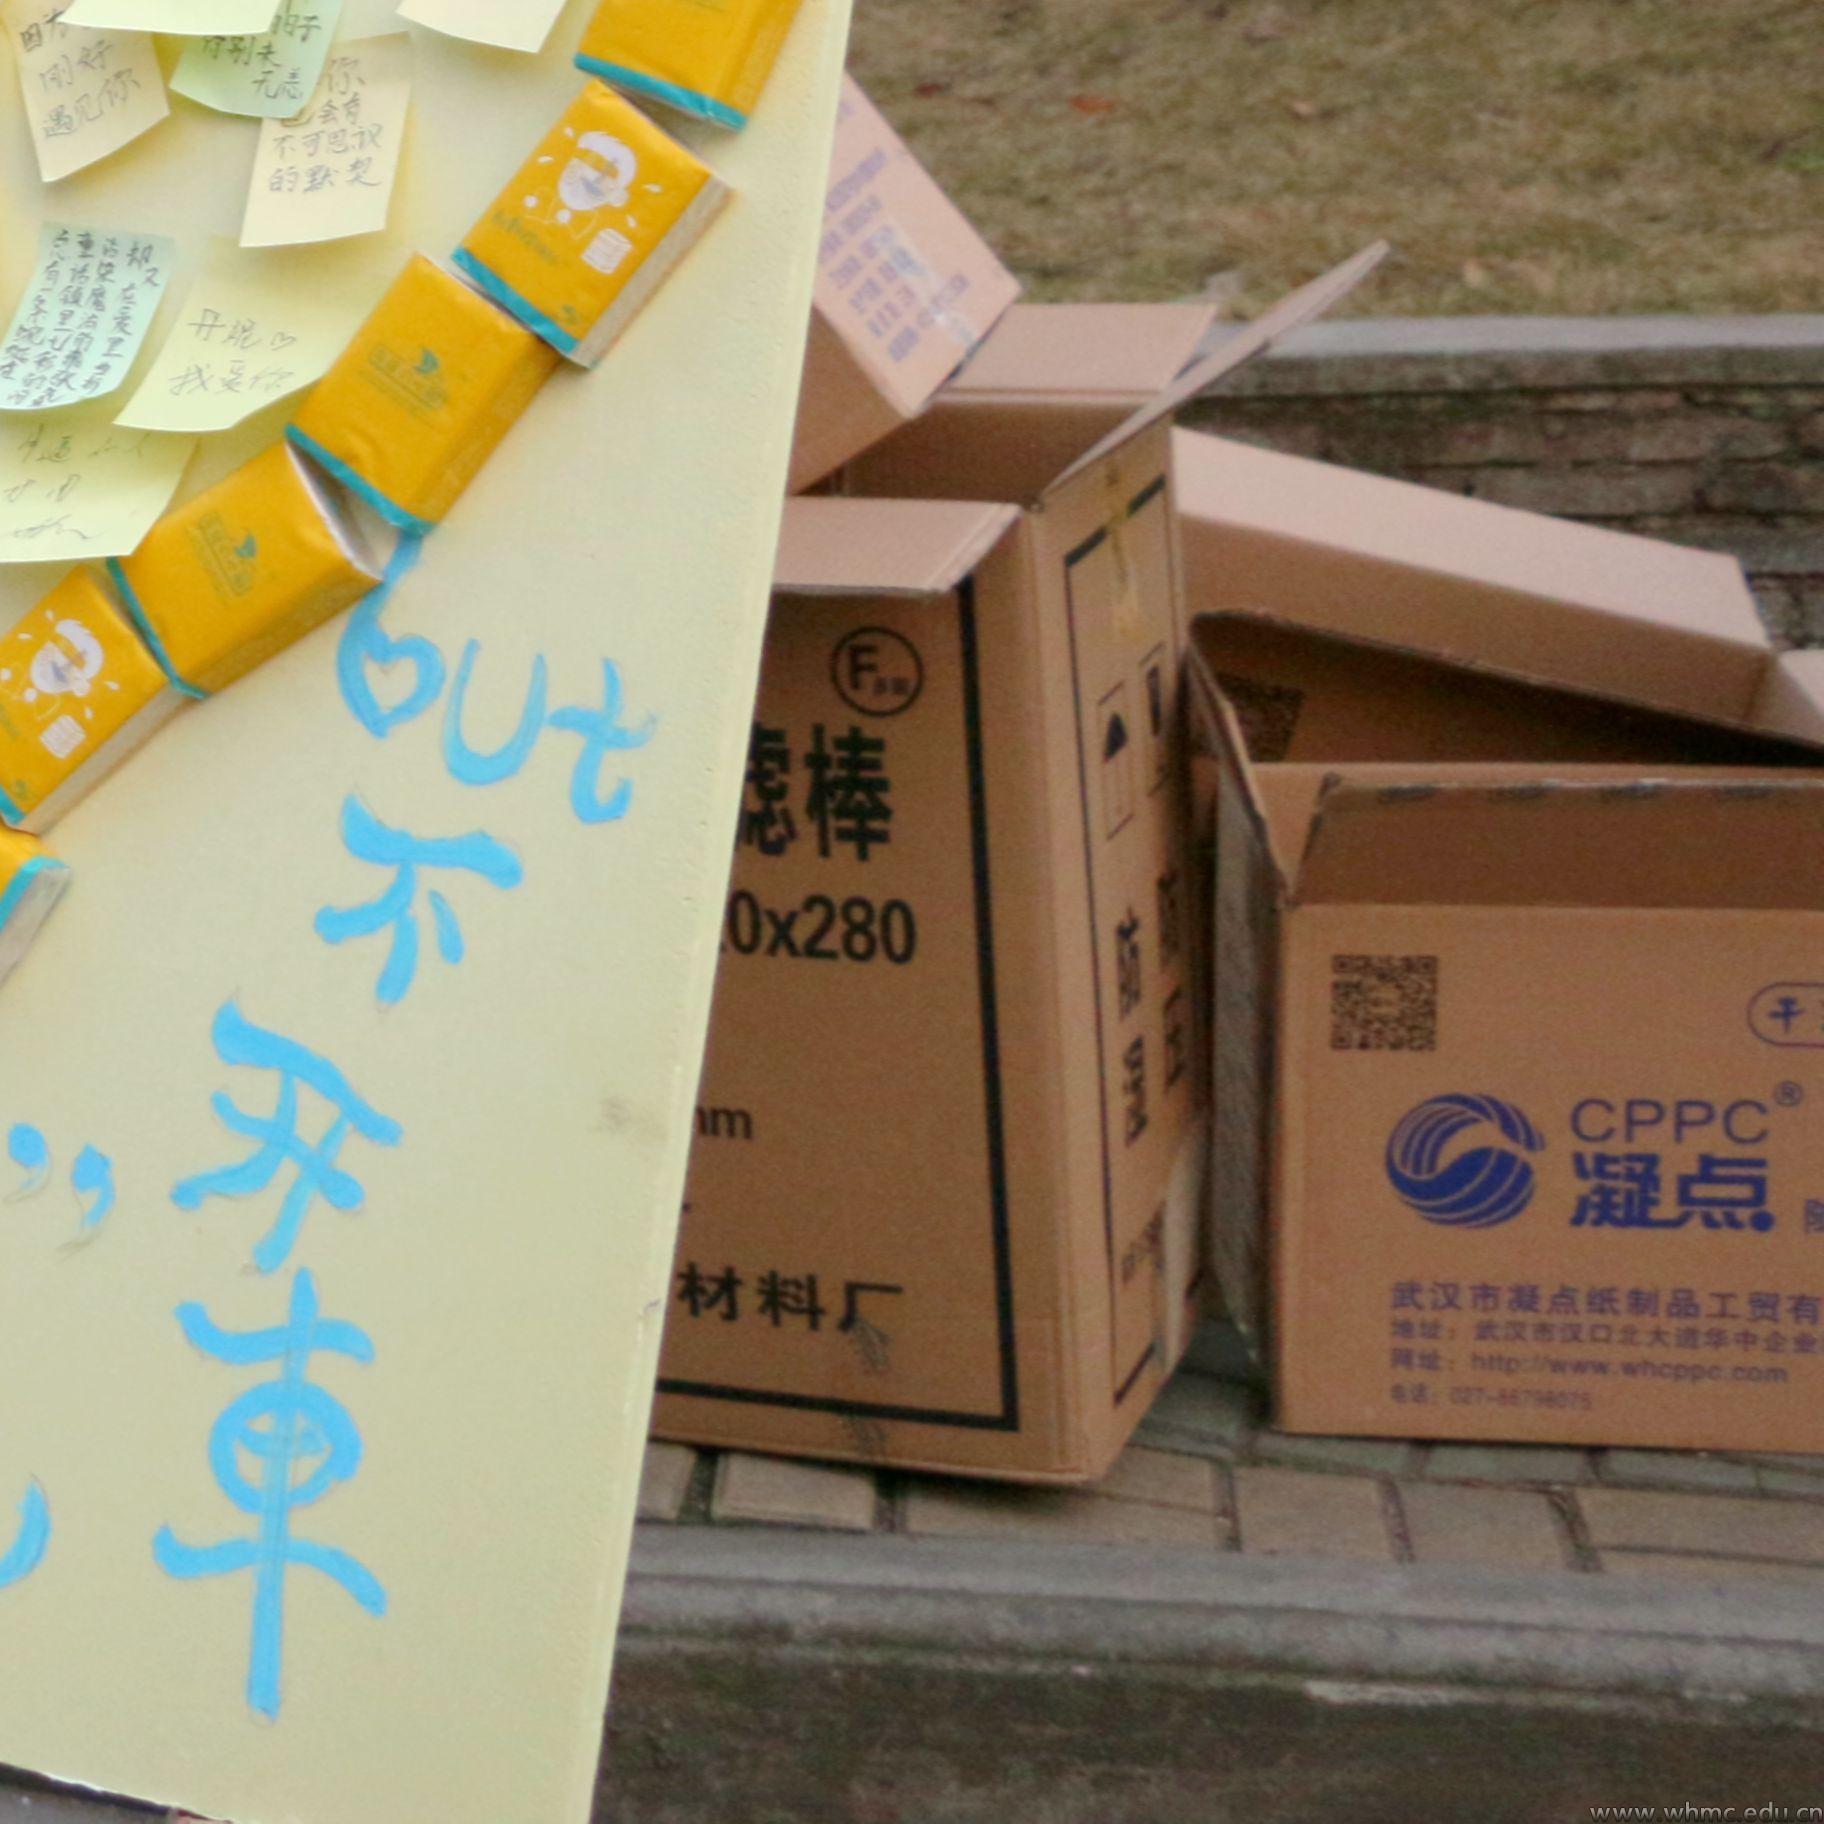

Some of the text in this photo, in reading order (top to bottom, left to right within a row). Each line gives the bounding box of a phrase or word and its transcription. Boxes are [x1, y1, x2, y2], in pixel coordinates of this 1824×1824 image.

[42, 67, 141, 139] 遇见你
[273, 122, 384, 160] 不可思议
[719, 888, 917, 965] 0x280
[1570, 1098, 1770, 1146] CPPC
[1570, 1152, 1775, 1231] 凝点
[676, 1260, 903, 1341] 材料厂
